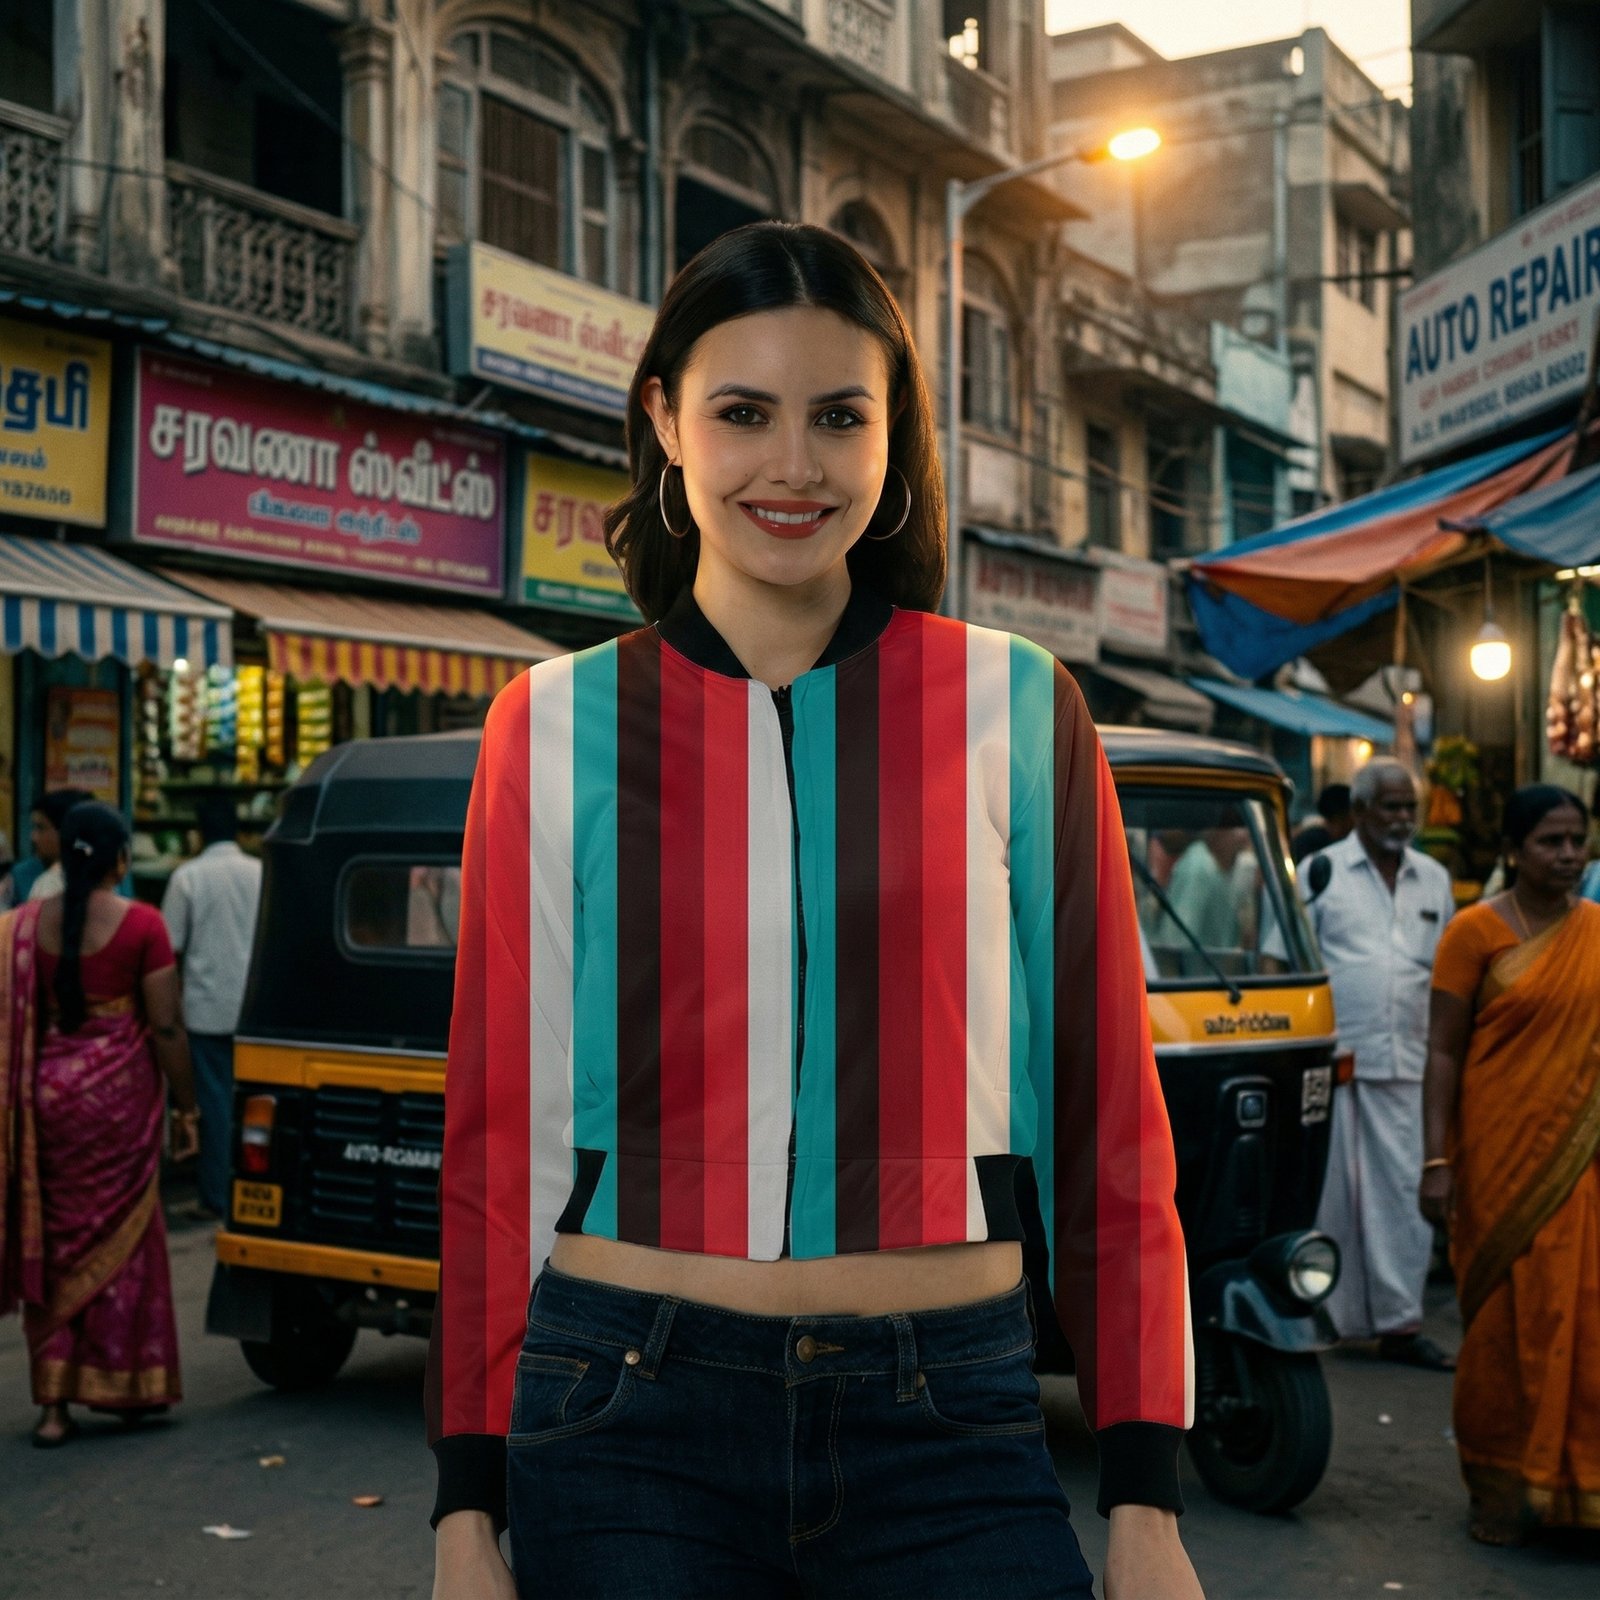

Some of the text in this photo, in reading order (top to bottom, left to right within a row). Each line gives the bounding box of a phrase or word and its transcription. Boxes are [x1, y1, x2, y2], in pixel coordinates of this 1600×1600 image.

[1405, 293, 1480, 384] AUTO
[1489, 225, 1600, 341] REPAIR
[149, 402, 340, 488] சரவணா
[348, 430, 496, 519] ஸ்வீட்ஸ்
